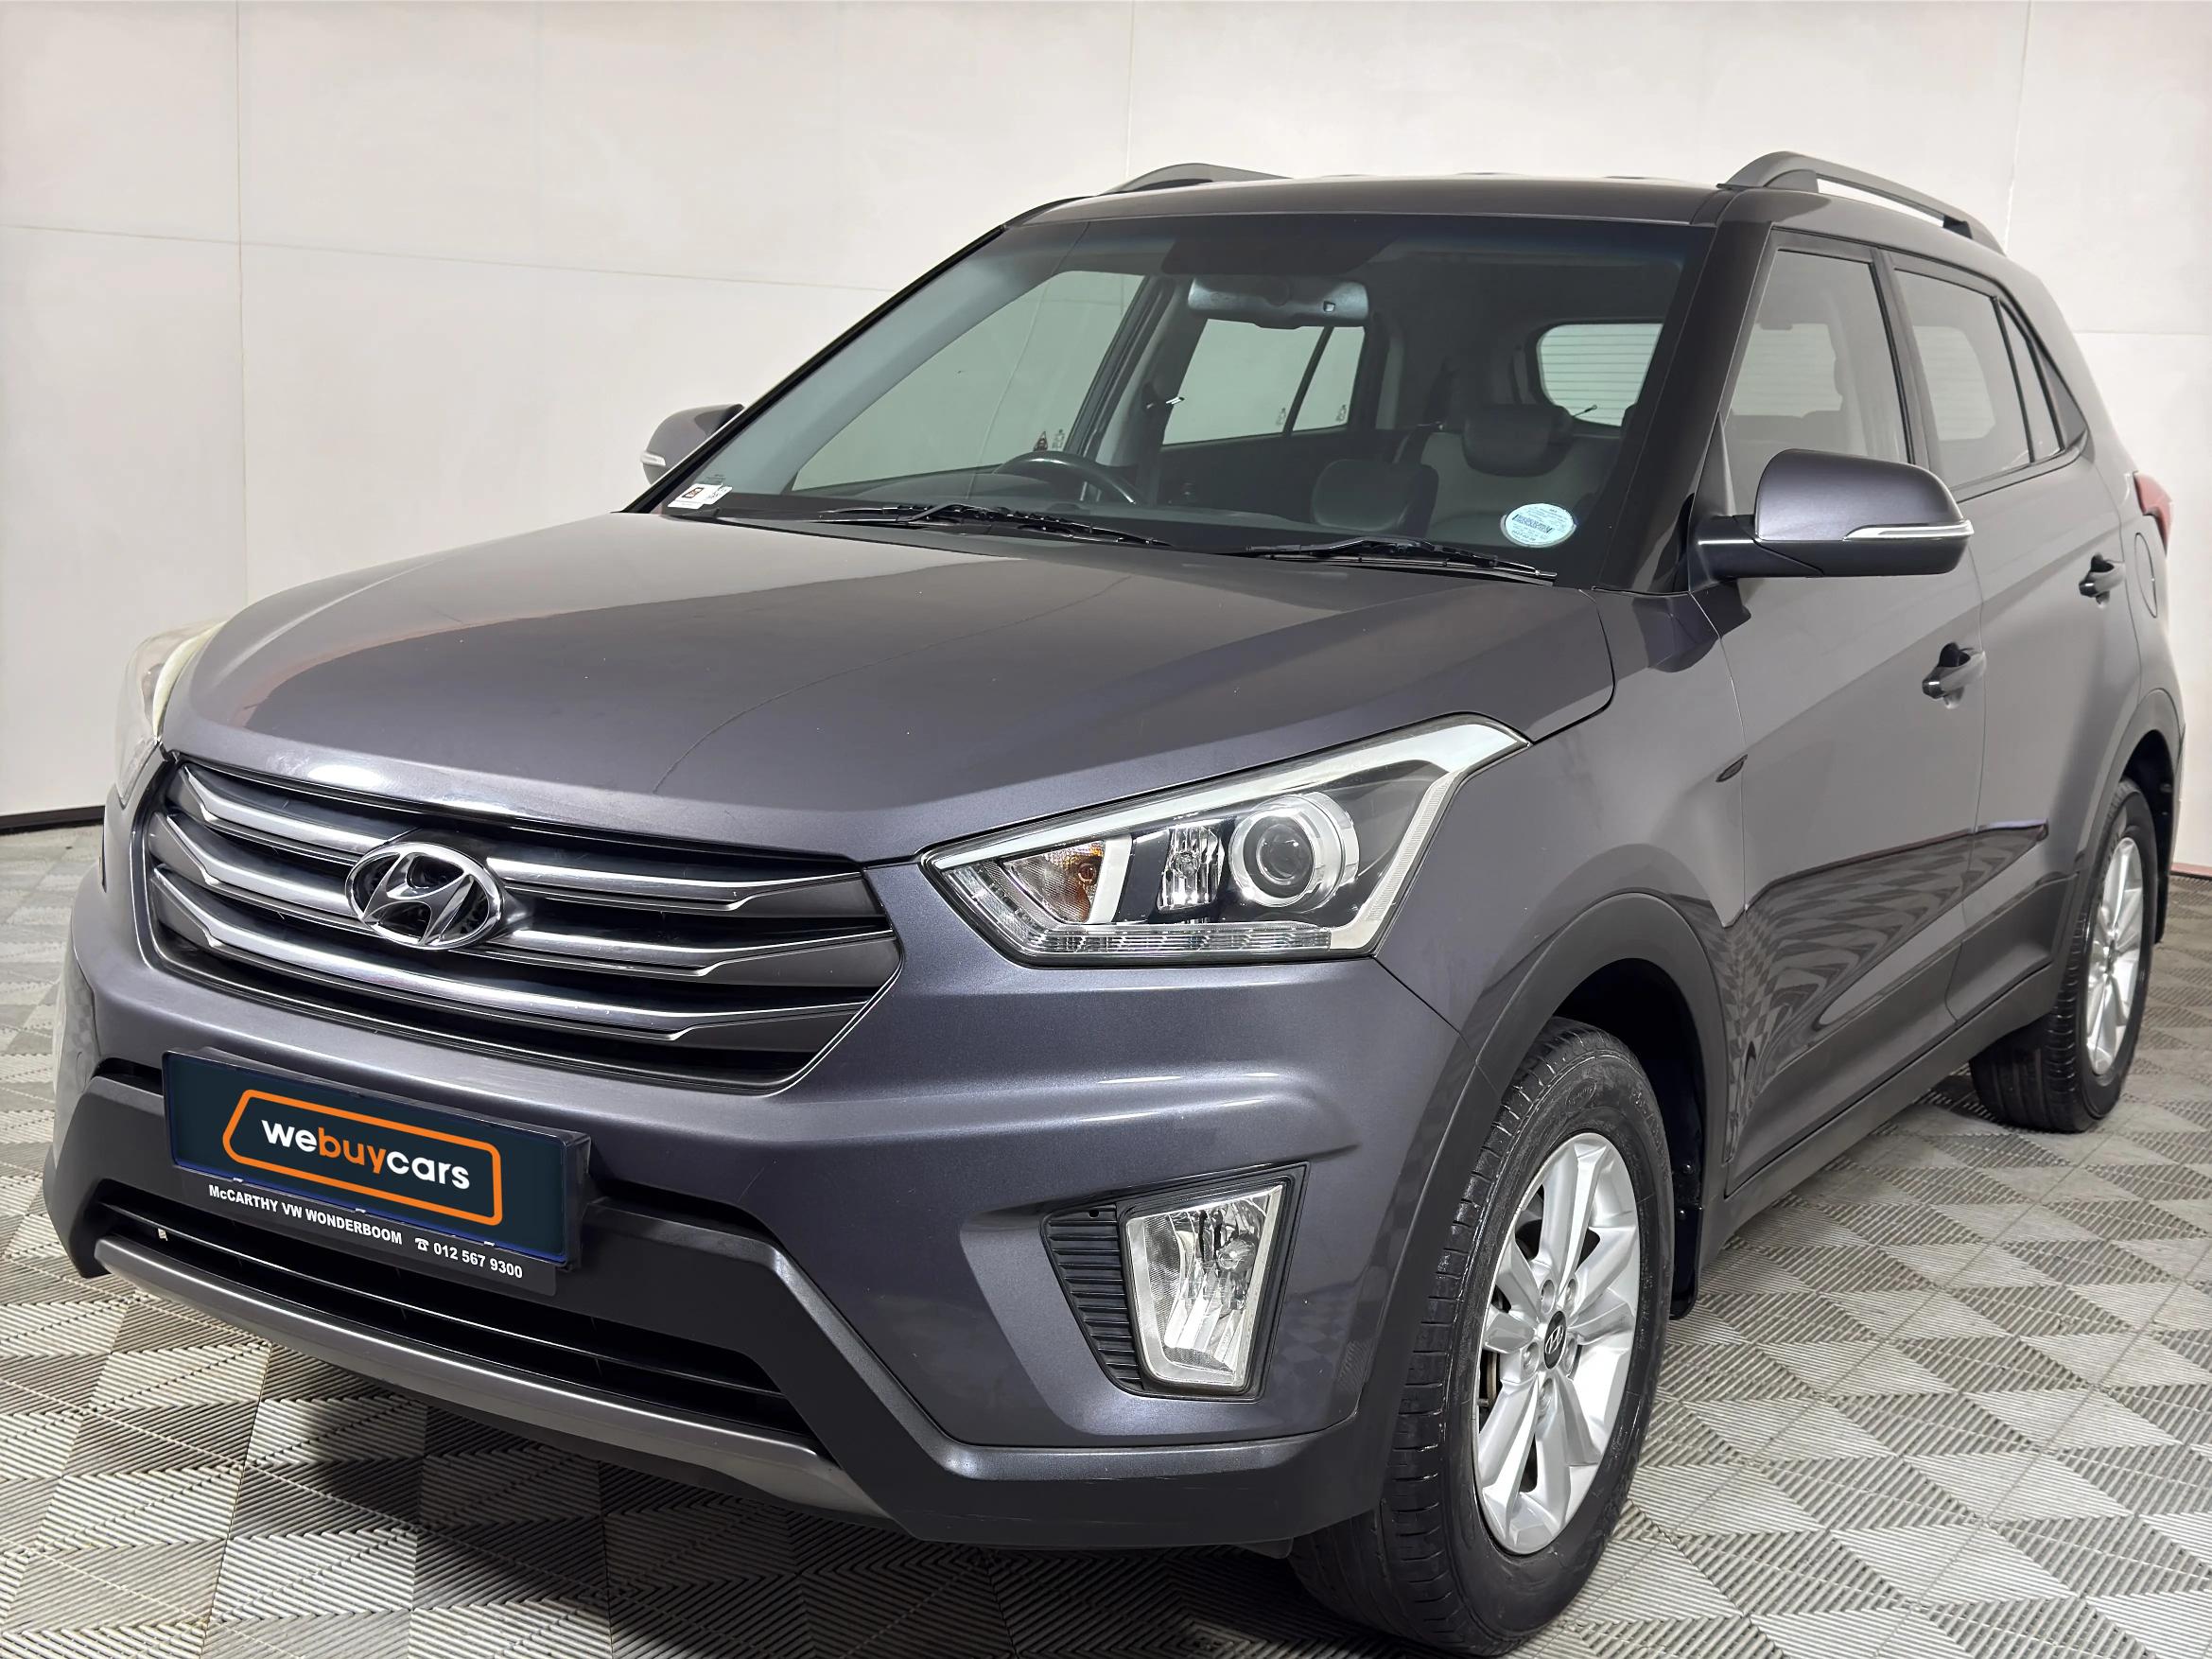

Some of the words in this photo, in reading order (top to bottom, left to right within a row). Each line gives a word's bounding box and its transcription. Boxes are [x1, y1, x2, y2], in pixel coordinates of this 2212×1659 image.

[261, 1119, 471, 1190] webuycars
[209, 1185, 278, 1213] McCARTHY
[282, 1202, 303, 1218] VW
[305, 1209, 403, 1245] WONDERBOOM
[433, 1242, 459, 1260] 012
[462, 1249, 485, 1267] 567
[490, 1258, 523, 1279] 9300
